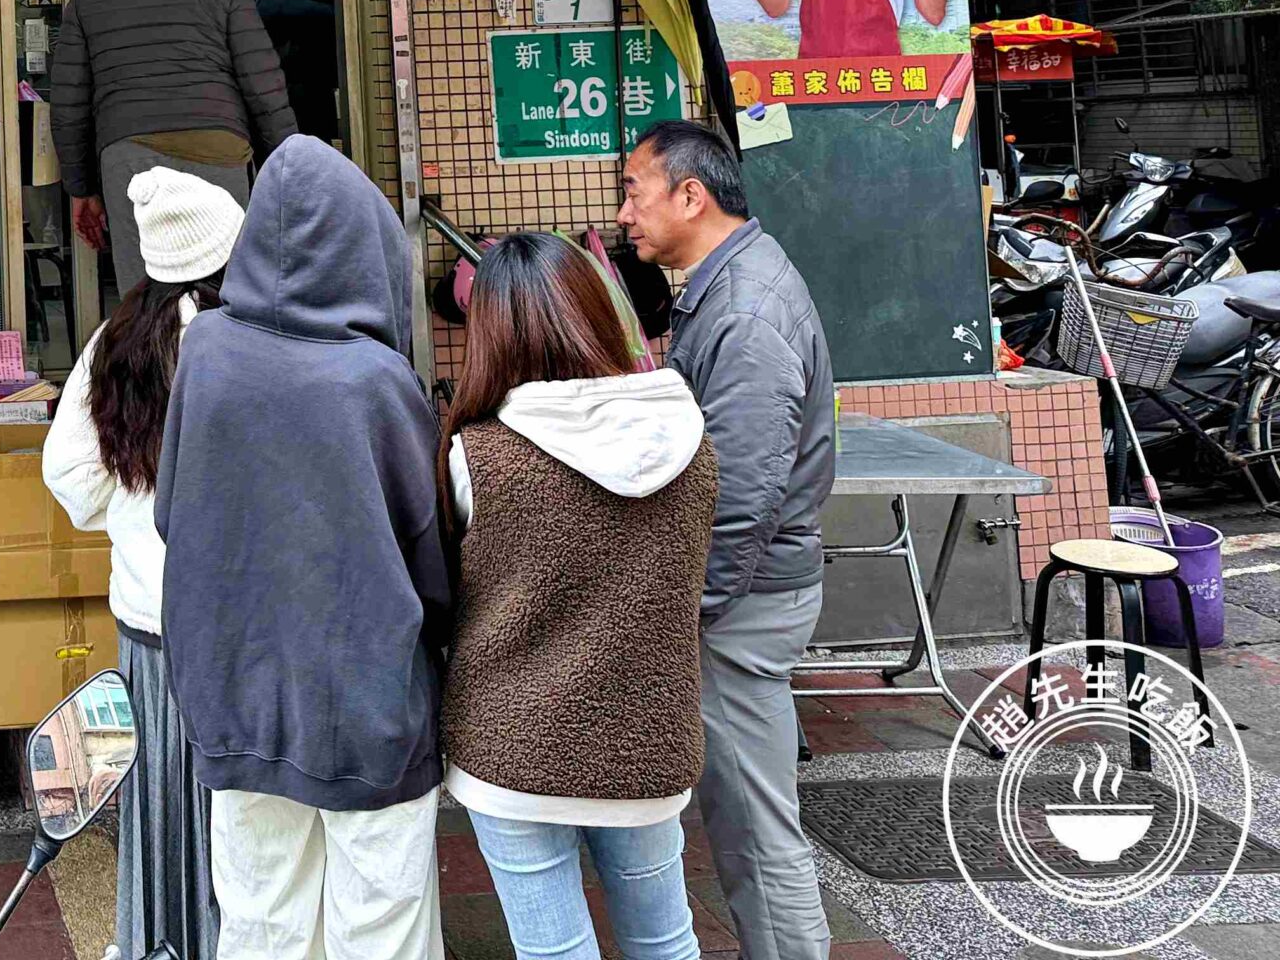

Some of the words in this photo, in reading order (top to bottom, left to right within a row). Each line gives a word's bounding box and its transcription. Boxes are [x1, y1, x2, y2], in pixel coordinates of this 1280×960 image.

[570, 0, 581, 21] 1
[515, 39, 653, 70] 新東街
[770, 66, 928, 97] 蕭家佈告欄
[521, 102, 554, 121] Lane
[544, 129, 610, 150] Sindong
